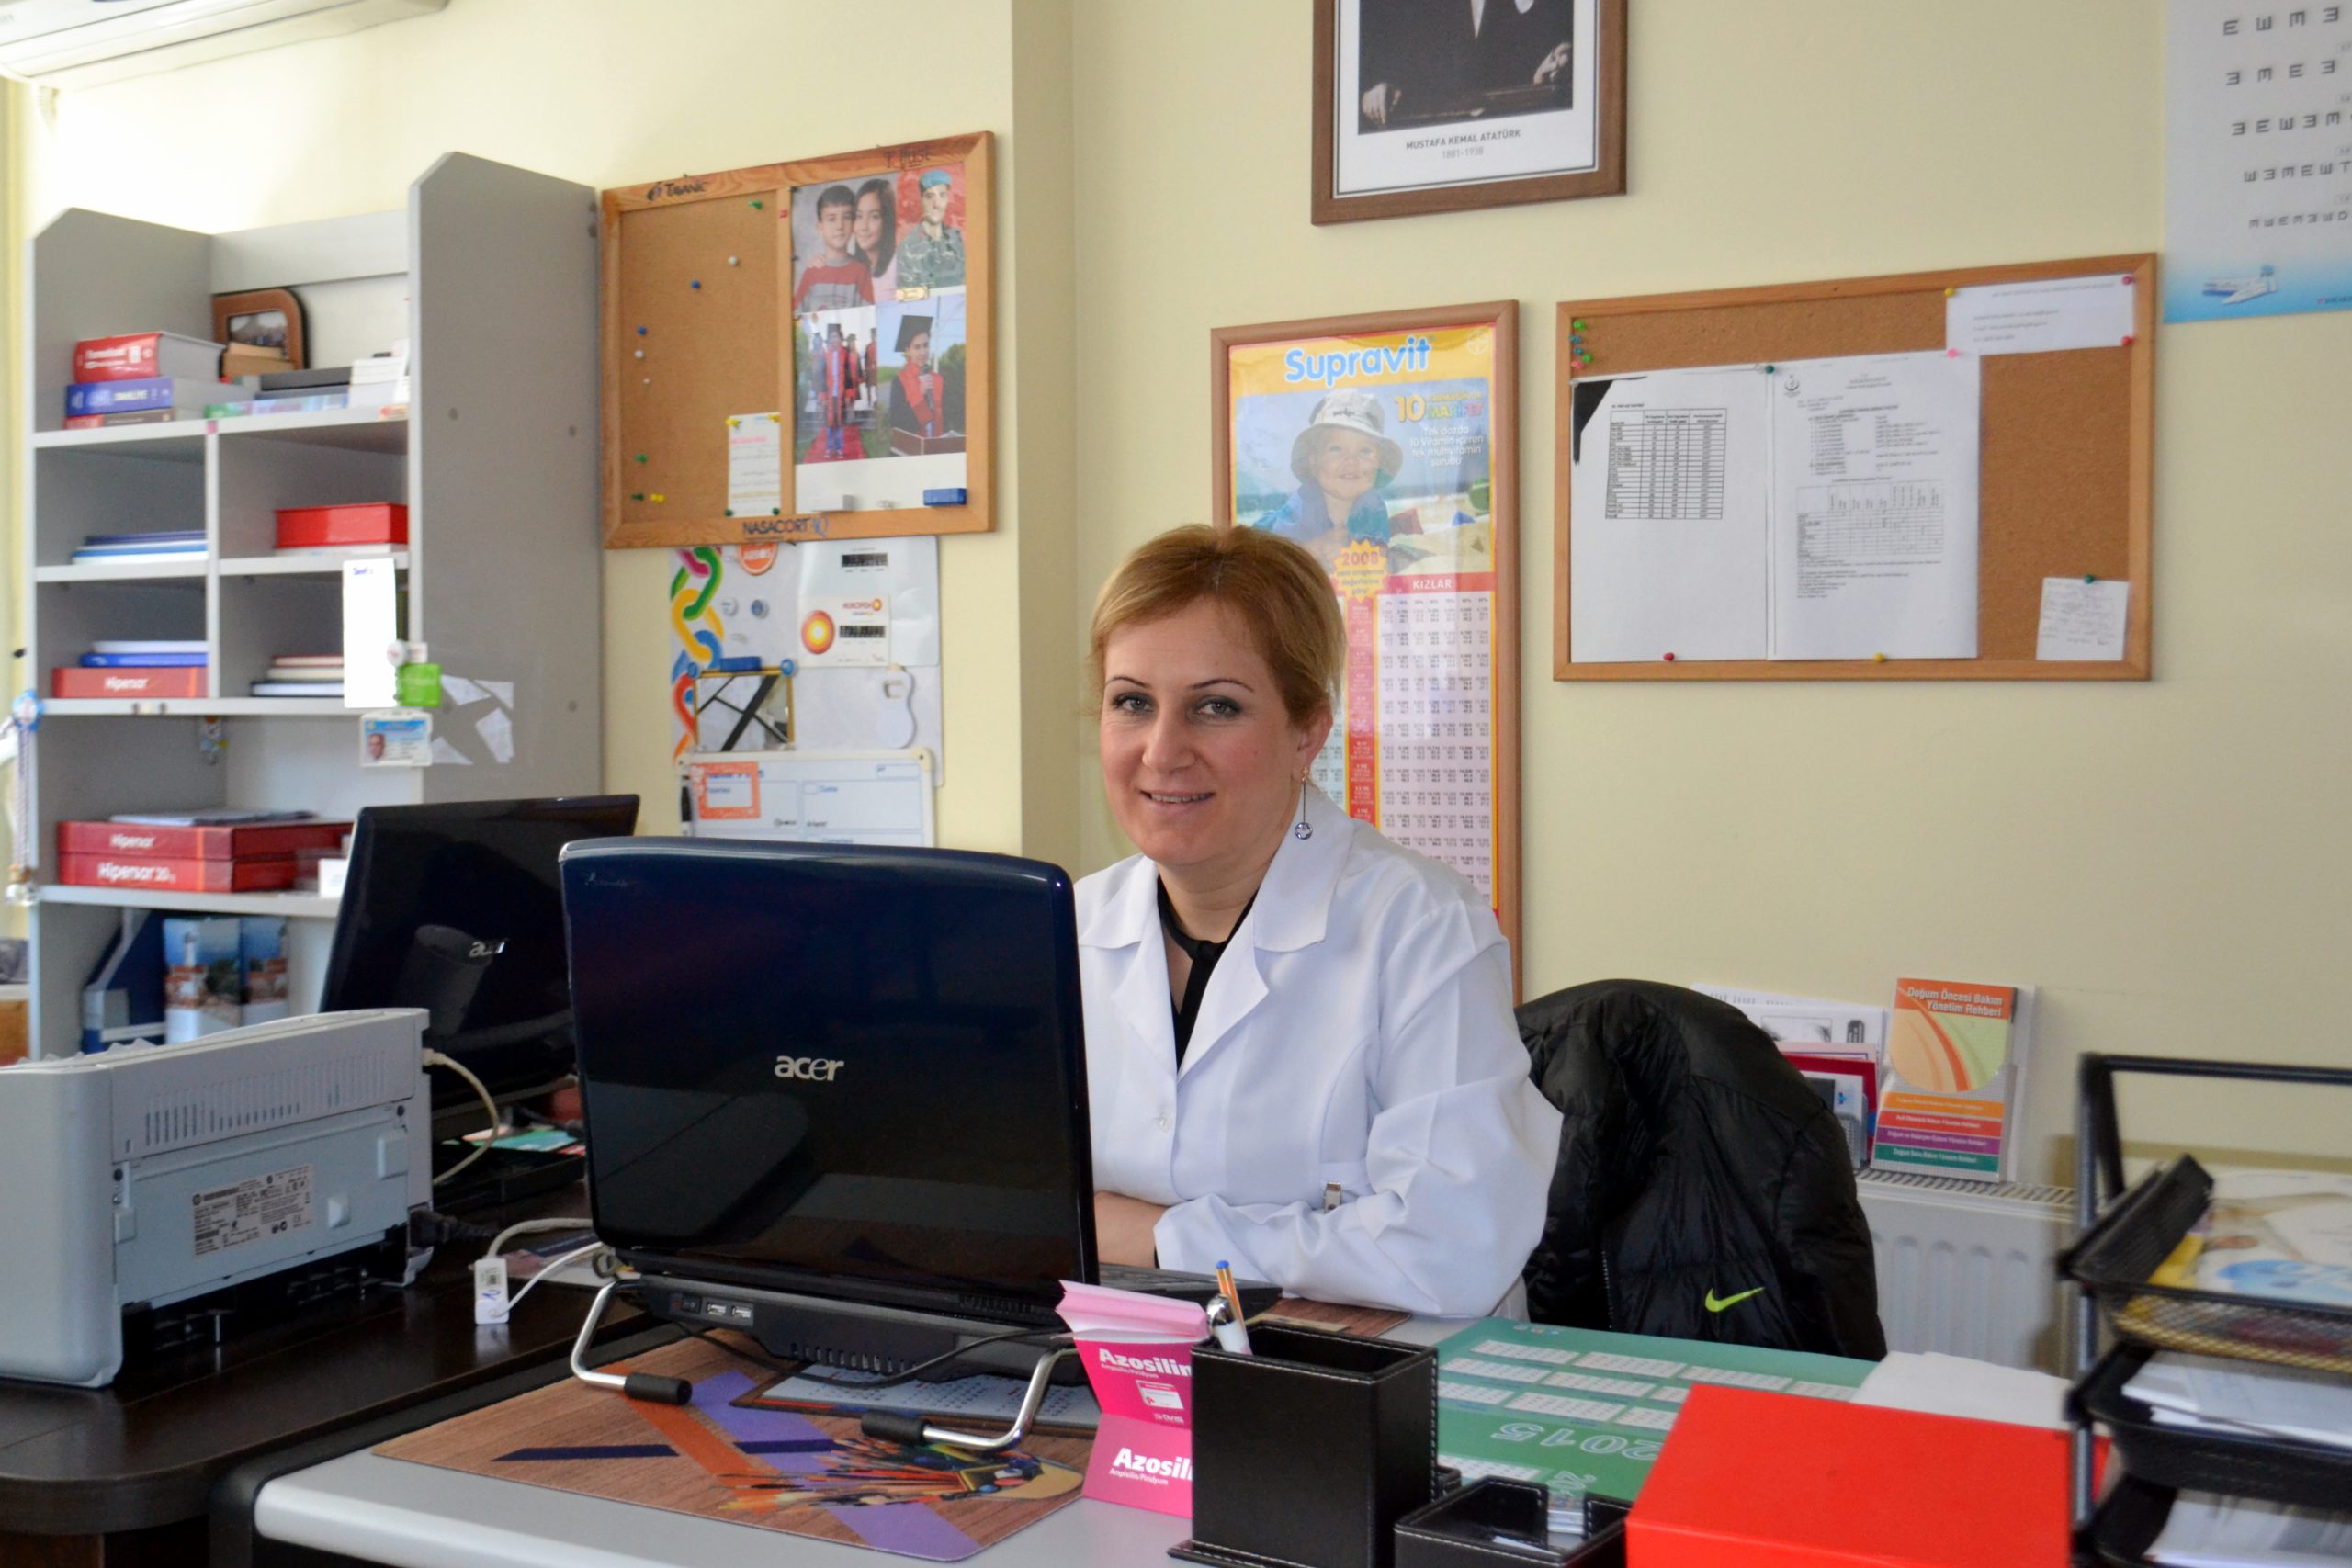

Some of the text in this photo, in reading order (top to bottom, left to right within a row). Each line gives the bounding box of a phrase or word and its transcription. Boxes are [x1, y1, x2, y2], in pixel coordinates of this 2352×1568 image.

[1406, 129, 1521, 150] MUSTAFA KEMAL ATATÜRK
[1442, 146, 1484, 159] 1881-1938
[1284, 335, 1430, 387] Supravit
[1395, 394, 1427, 423] 10
[742, 517, 809, 534] NASACORT
[1412, 579, 1453, 590] KIZLAR
[1907, 987, 2003, 1005] Doğum Öncesi Bakım
[1928, 999, 2001, 1016] Yönetim Rehberi
[774, 1055, 844, 1081] acer
[1490, 1422, 1666, 1461] 2015
